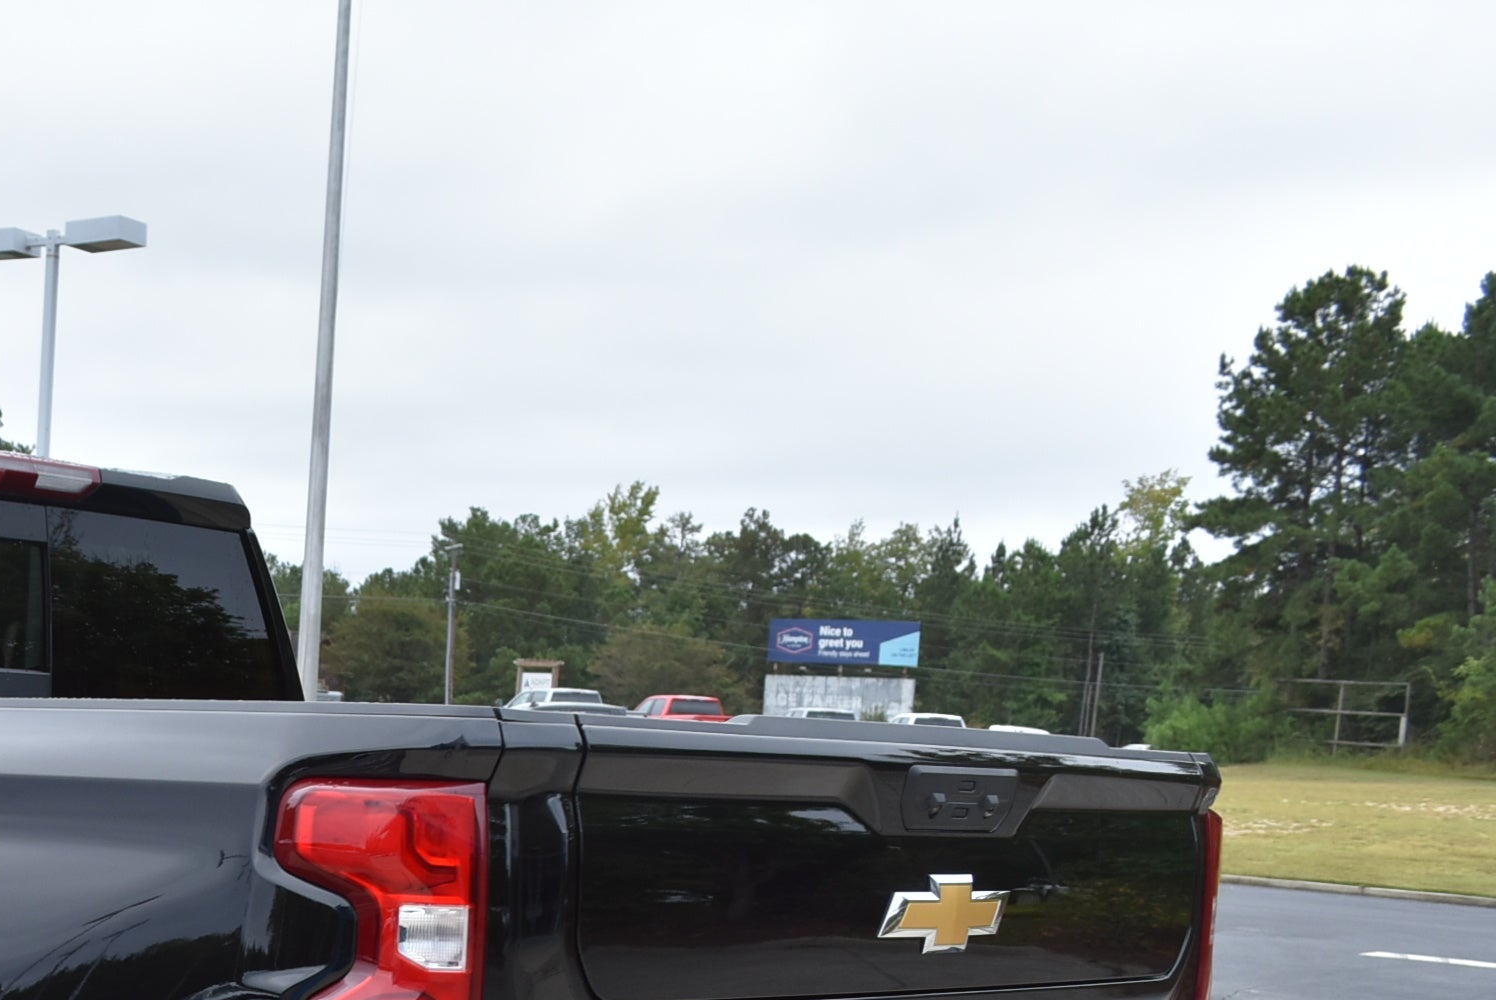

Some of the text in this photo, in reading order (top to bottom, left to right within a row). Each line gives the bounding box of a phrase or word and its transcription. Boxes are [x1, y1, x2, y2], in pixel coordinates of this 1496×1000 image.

[819, 625, 854, 637] Nice to
[818, 638, 864, 650] greet you
